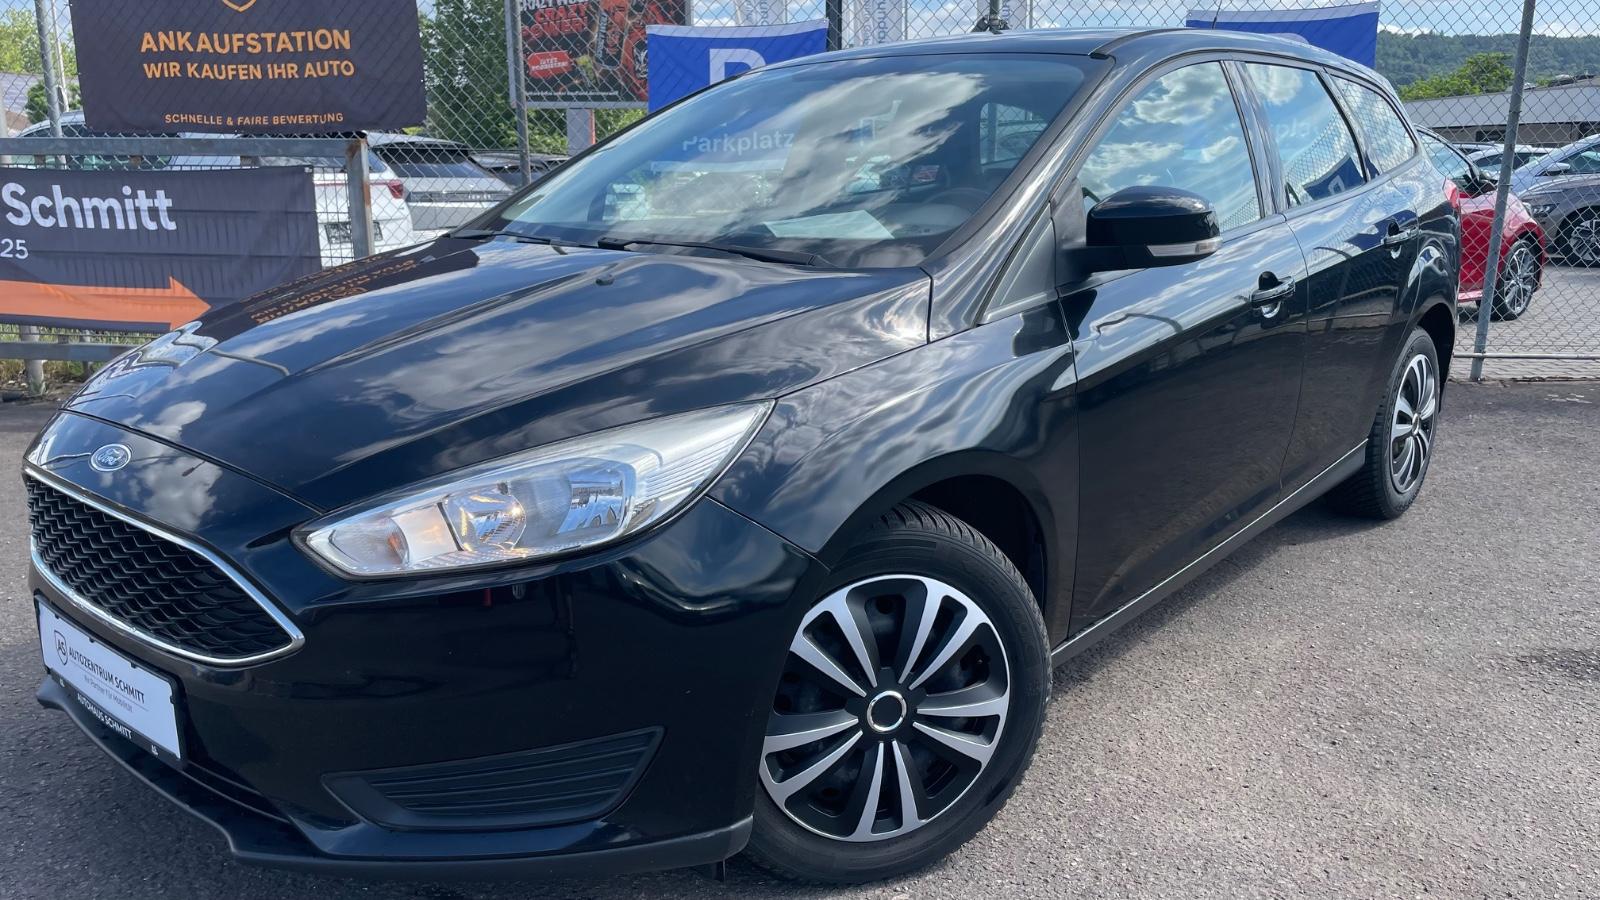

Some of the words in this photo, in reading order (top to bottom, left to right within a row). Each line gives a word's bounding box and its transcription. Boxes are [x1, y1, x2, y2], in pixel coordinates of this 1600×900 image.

[140, 28, 351, 54] ANKAUFSTATION
[143, 61, 181, 78] WIR
[187, 62, 262, 80] KAUFEN
[267, 63, 299, 79] IHR
[304, 60, 355, 78] AUTO
[165, 113, 223, 125] SCHNELLE
[226, 116, 234, 126] &
[237, 116, 269, 126] FAIRE
[272, 112, 344, 125] BEWERTUNG
[1, 182, 177, 231] Schmitt
[0, 238, 29, 259] 25
[68, 646, 115, 685] AUTOZENTRUM
[114, 676, 145, 704] SCHMITT
[77, 692, 104, 722] AUTOHAUS
[104, 715, 132, 740] SCHMITT
